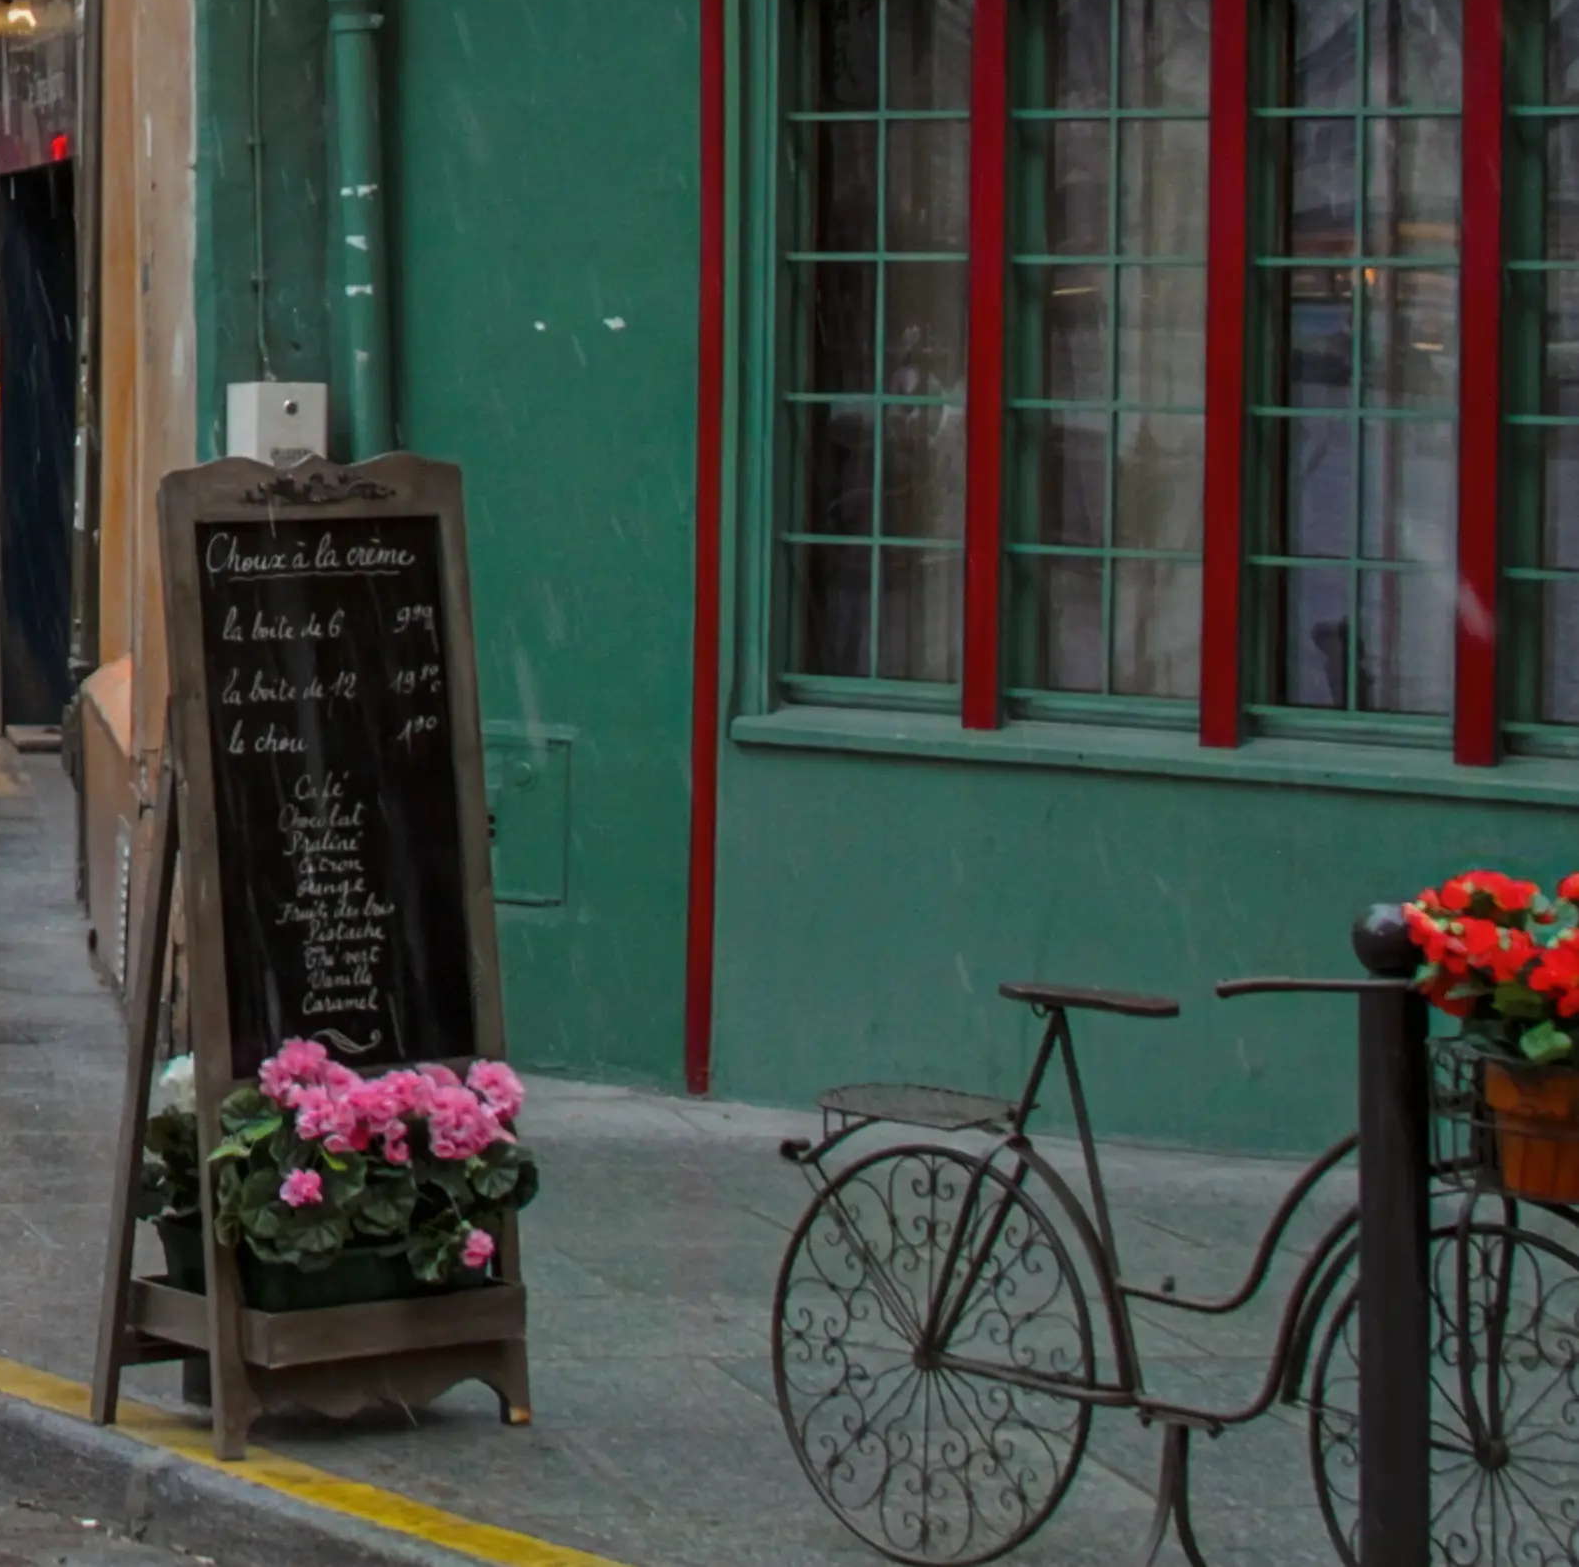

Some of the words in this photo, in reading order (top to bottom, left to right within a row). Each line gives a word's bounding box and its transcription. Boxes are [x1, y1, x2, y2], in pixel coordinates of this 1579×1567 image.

[206, 532, 286, 573] Choux
[292, 540, 310, 568] à
[315, 532, 341, 568] la
[347, 538, 416, 566] crème
[222, 605, 244, 641] la
[300, 612, 324, 638] de
[328, 609, 346, 638] 6
[222, 667, 243, 705] la
[302, 676, 325, 700] de
[328, 670, 357, 700] 12
[228, 720, 245, 754] le
[254, 722, 308, 752] chou
[292, 771, 350, 808] Café
[278, 802, 366, 832] Chocolat
[299, 853, 365, 873] Citron
[303, 919, 385, 945] Pistache
[307, 965, 374, 990] Vanille
[302, 987, 379, 1015] Caramel
